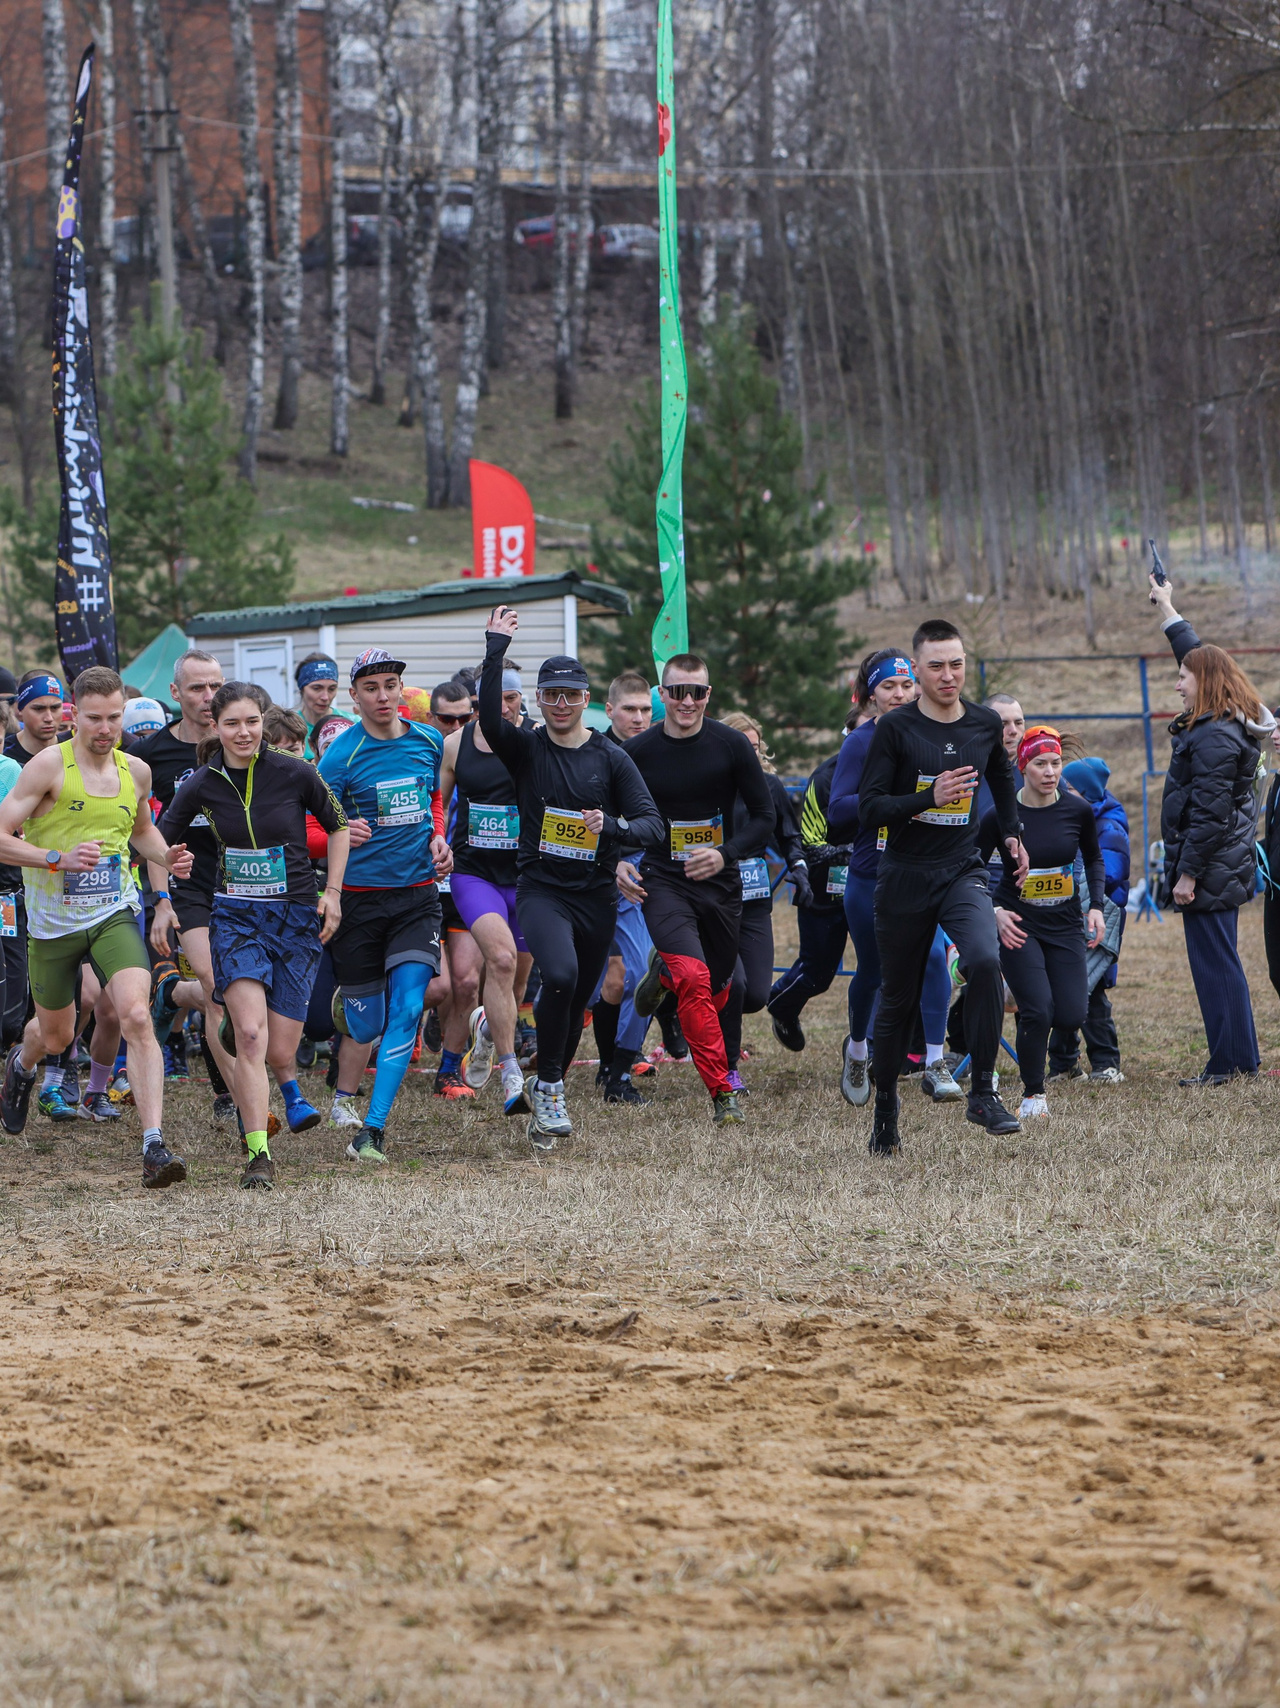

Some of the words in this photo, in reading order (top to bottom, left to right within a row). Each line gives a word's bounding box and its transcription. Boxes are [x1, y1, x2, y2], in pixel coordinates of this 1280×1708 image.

[390, 790, 419, 807] 455
[479, 817, 508, 831] 464
[556, 822, 587, 840] 952
[684, 830, 713, 844] 958
[239, 862, 272, 877] 403
[78, 870, 110, 887] 298
[1035, 878, 1063, 892] 915
